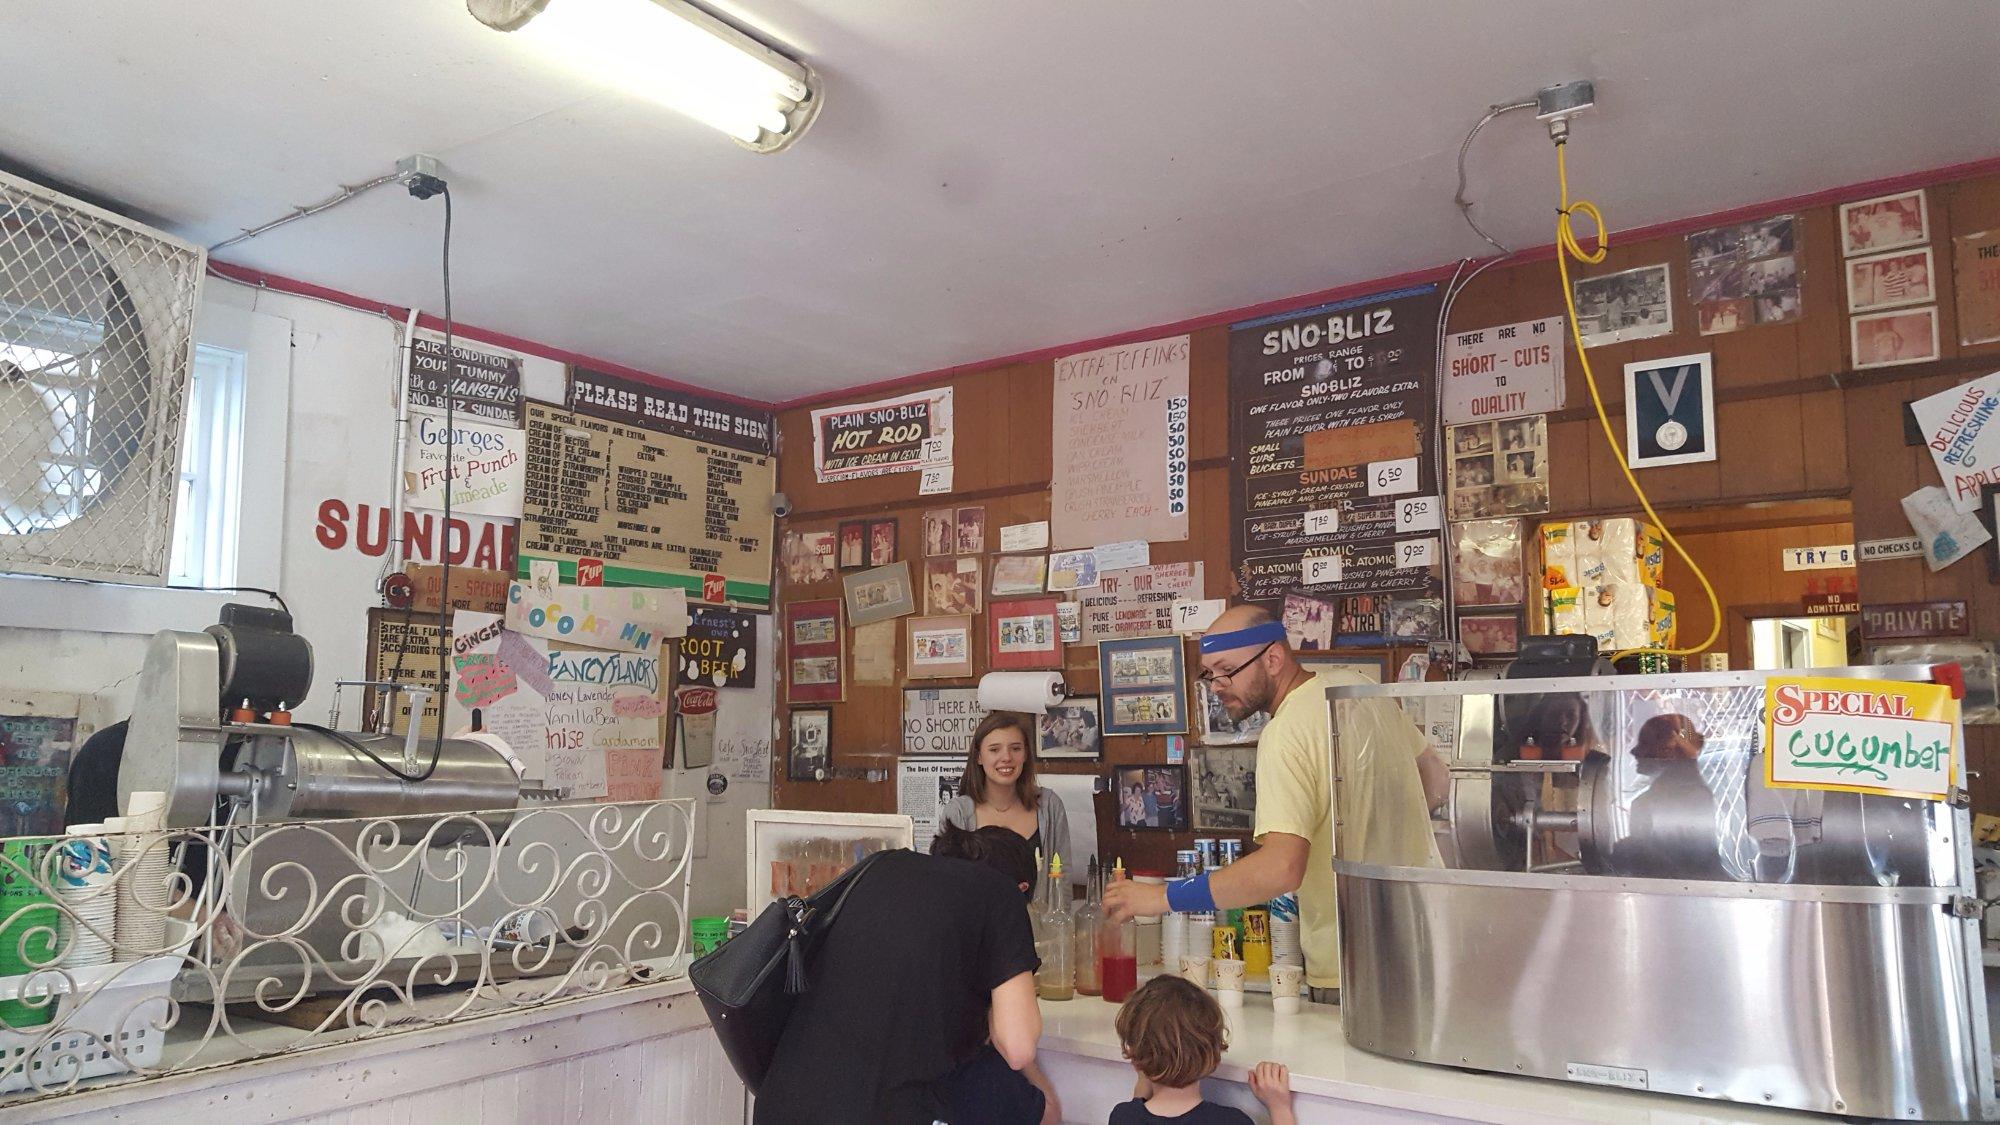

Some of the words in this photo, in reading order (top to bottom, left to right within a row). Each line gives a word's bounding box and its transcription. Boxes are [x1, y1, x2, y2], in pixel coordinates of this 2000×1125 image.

[1978, 244, 2000, 259] THE
[1262, 310, 1394, 356] SNO-BLIZ
[1457, 332, 1484, 347] THERE
[1498, 327, 1516, 340] ARE
[1533, 322, 1545, 334] NO
[415, 340, 441, 355] AIR
[1294, 353, 1323, 365] PRICES
[1329, 346, 1363, 358] RANGE
[1452, 354, 1496, 377] SHORT
[1514, 345, 1550, 367] CUTS
[456, 363, 506, 383] TUMMY
[1264, 367, 1304, 386] FROM
[1345, 356, 1364, 371] TO
[410, 374, 425, 391] ith
[1301, 376, 1362, 398] SNO-BLIZ
[1495, 376, 1507, 387] TO
[1250, 406, 1268, 415] ONE
[1269, 399, 1304, 412] FLAVOR
[1350, 385, 1390, 399] FLAVORS
[1391, 381, 1419, 392] EXTRA
[1471, 392, 1526, 416] QUALITY
[472, 404, 516, 422] SUNDAE
[574, 380, 638, 412] PLEASE
[644, 396, 688, 423] READ
[693, 408, 730, 432] THIS
[734, 416, 768, 440] SIGN
[831, 413, 864, 429] PLAIN
[869, 404, 926, 424] SNO-BLIZ
[1265, 420, 1289, 429] THESE
[1293, 414, 1321, 424] PRICES
[1325, 410, 1343, 419] ONE
[1347, 404, 1379, 417] FLAVOR
[1382, 402, 1404, 413] ONLY
[530, 408, 544, 418] OUR
[551, 414, 576, 426] SPECIAL
[580, 420, 608, 433] FLAVORS
[612, 426, 623, 436] ARE
[626, 430, 646, 441] EXTRA
[1264, 429, 1290, 439] PLAIN
[1293, 423, 1326, 435] FLAVOR
[1328, 418, 1349, 429] WITH
[1351, 417, 1366, 425] ICE
[1377, 411, 1404, 422] SYRUP
[1930, 386, 1985, 452] DELICIOUS
[1169, 423, 1184, 433] 50
[1943, 397, 1999, 465] REFRESHING
[420, 418, 504, 456] Georges
[832, 430, 872, 453] HOT
[878, 423, 922, 444] ROD
[1168, 435, 1184, 447] 50
[637, 452, 655, 462] EXTRA
[1168, 448, 1184, 460] 50
[1249, 443, 1280, 455] SMALL
[467, 450, 518, 478] Punch
[824, 458, 842, 470] WITH
[846, 456, 858, 467] ICE
[861, 453, 888, 465] CREAM
[891, 452, 900, 461] IN
[1169, 461, 1186, 473] 50
[1250, 454, 1275, 464] CUPS
[1250, 460, 1295, 475] BUCKETS
[1169, 474, 1184, 486] 50
[1299, 466, 1358, 485] SUNDAE
[440, 478, 508, 508] Lmeade
[1169, 488, 1184, 500] 50
[1254, 496, 1293, 508] PINEAPPLE
[1296, 495, 1314, 503] AND
[1318, 491, 1350, 501] CHERRY
[1285, 534, 1346, 545] MARSHMELLOW
[1304, 545, 1355, 557] ATOMIC
[1796, 550, 1826, 564] TRY
[1864, 546, 1875, 555] NO
[1878, 542, 1910, 554] CHECKS
[1356, 555, 1396, 566] ATOMIC
[1376, 568, 1419, 577] PINEAPPLE
[1134, 575, 1152, 590] OUR
[1167, 580, 1192, 589] CHERRY
[1302, 581, 1366, 592] MARSHMELLOW
[1380, 579, 1415, 588] CHERRY
[1085, 596, 1118, 607] DELICIOUS
[1137, 592, 1177, 603] REFRESHING
[1254, 588, 1266, 596] ICE
[1828, 595, 1840, 603] NO
[1092, 612, 1109, 621] PURE
[1115, 609, 1147, 620] LEMONADE
[1156, 608, 1170, 618] BLIZ
[1872, 610, 1960, 631] PRIVATE
[1092, 624, 1110, 633] PURE
[1157, 619, 1172, 629] BLIZ
[680, 638, 724, 657] ROOT
[701, 659, 738, 679] BEER
[577, 686, 617, 703] Lavender
[920, 691, 966, 715] THERE
[1773, 685, 1914, 724] SPECIAL
[545, 705, 593, 725] Vanilla
[904, 719, 921, 733] NO
[926, 718, 966, 732] SHORT
[906, 736, 925, 750] TO
[932, 736, 974, 751] QUALIT
